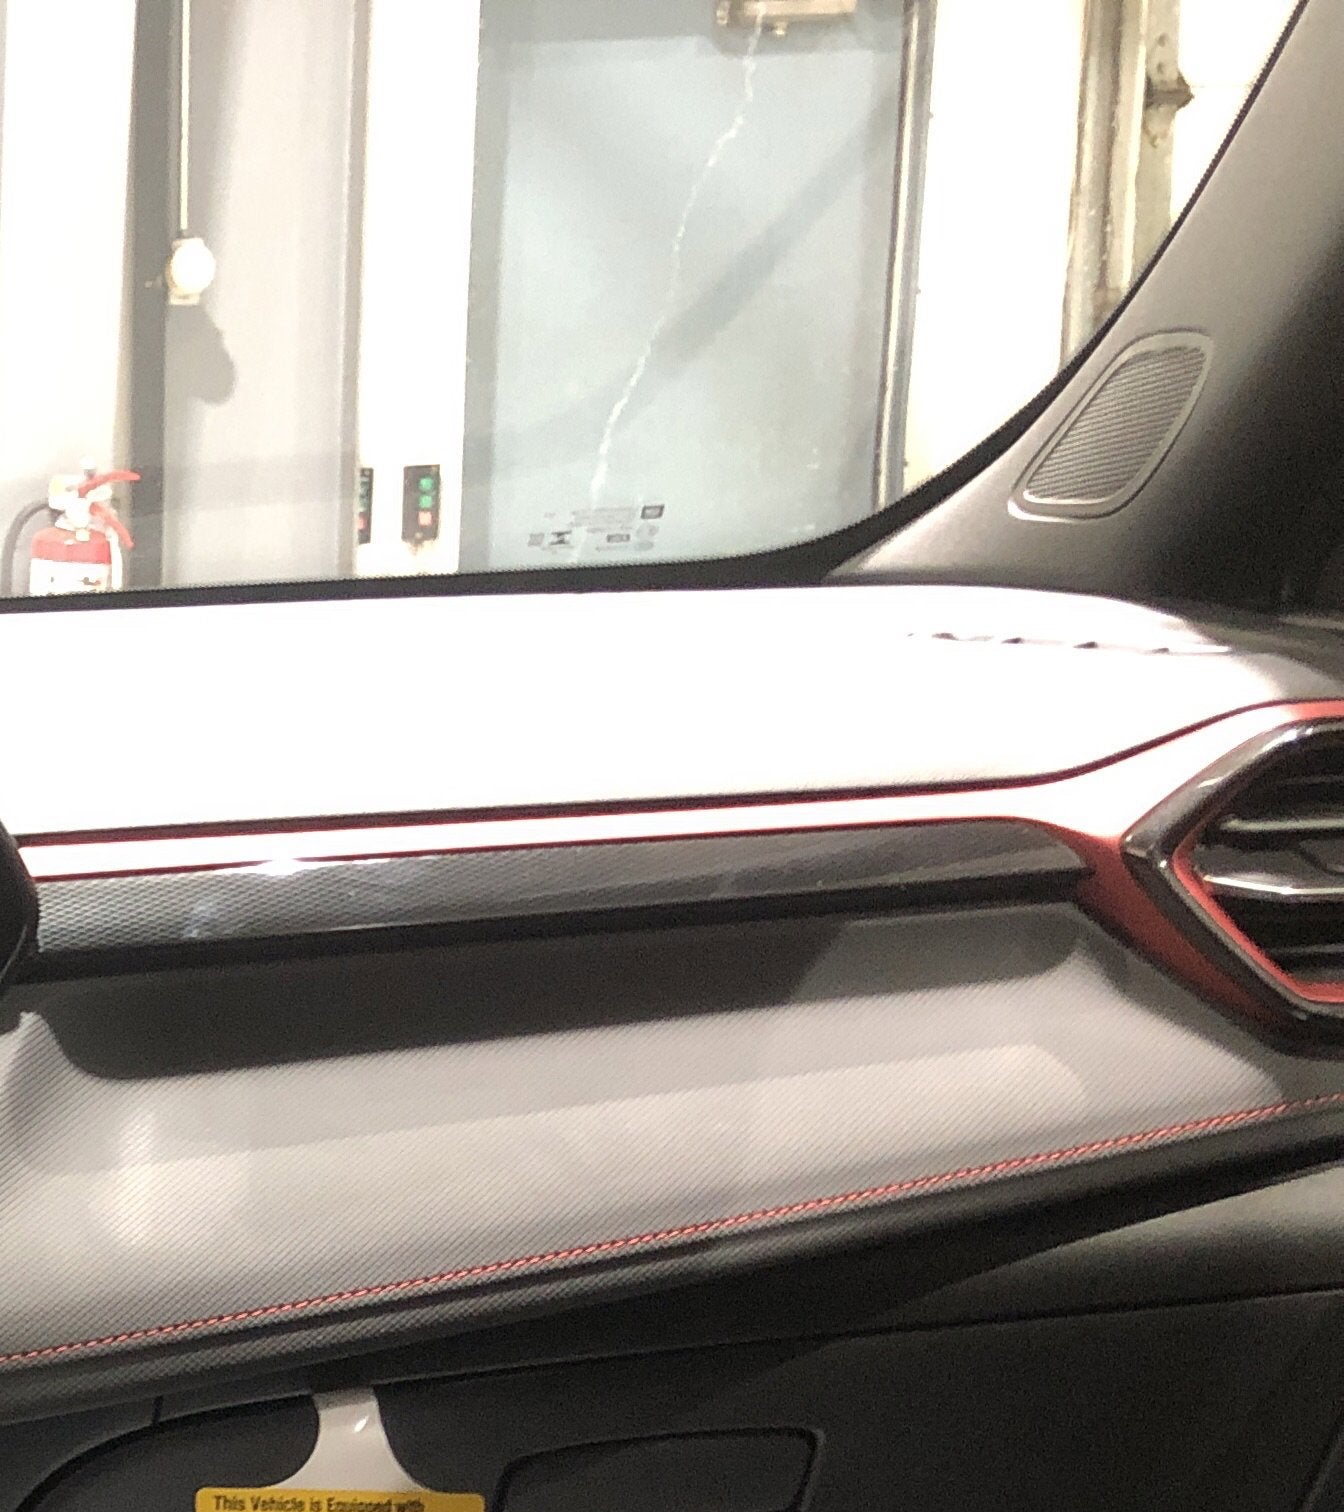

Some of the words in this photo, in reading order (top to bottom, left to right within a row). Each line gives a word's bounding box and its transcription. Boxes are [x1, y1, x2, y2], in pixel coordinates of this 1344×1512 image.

[213, 1495, 245, 1511] This
[250, 1496, 305, 1512] Vehicle
[310, 1497, 321, 1512] is
